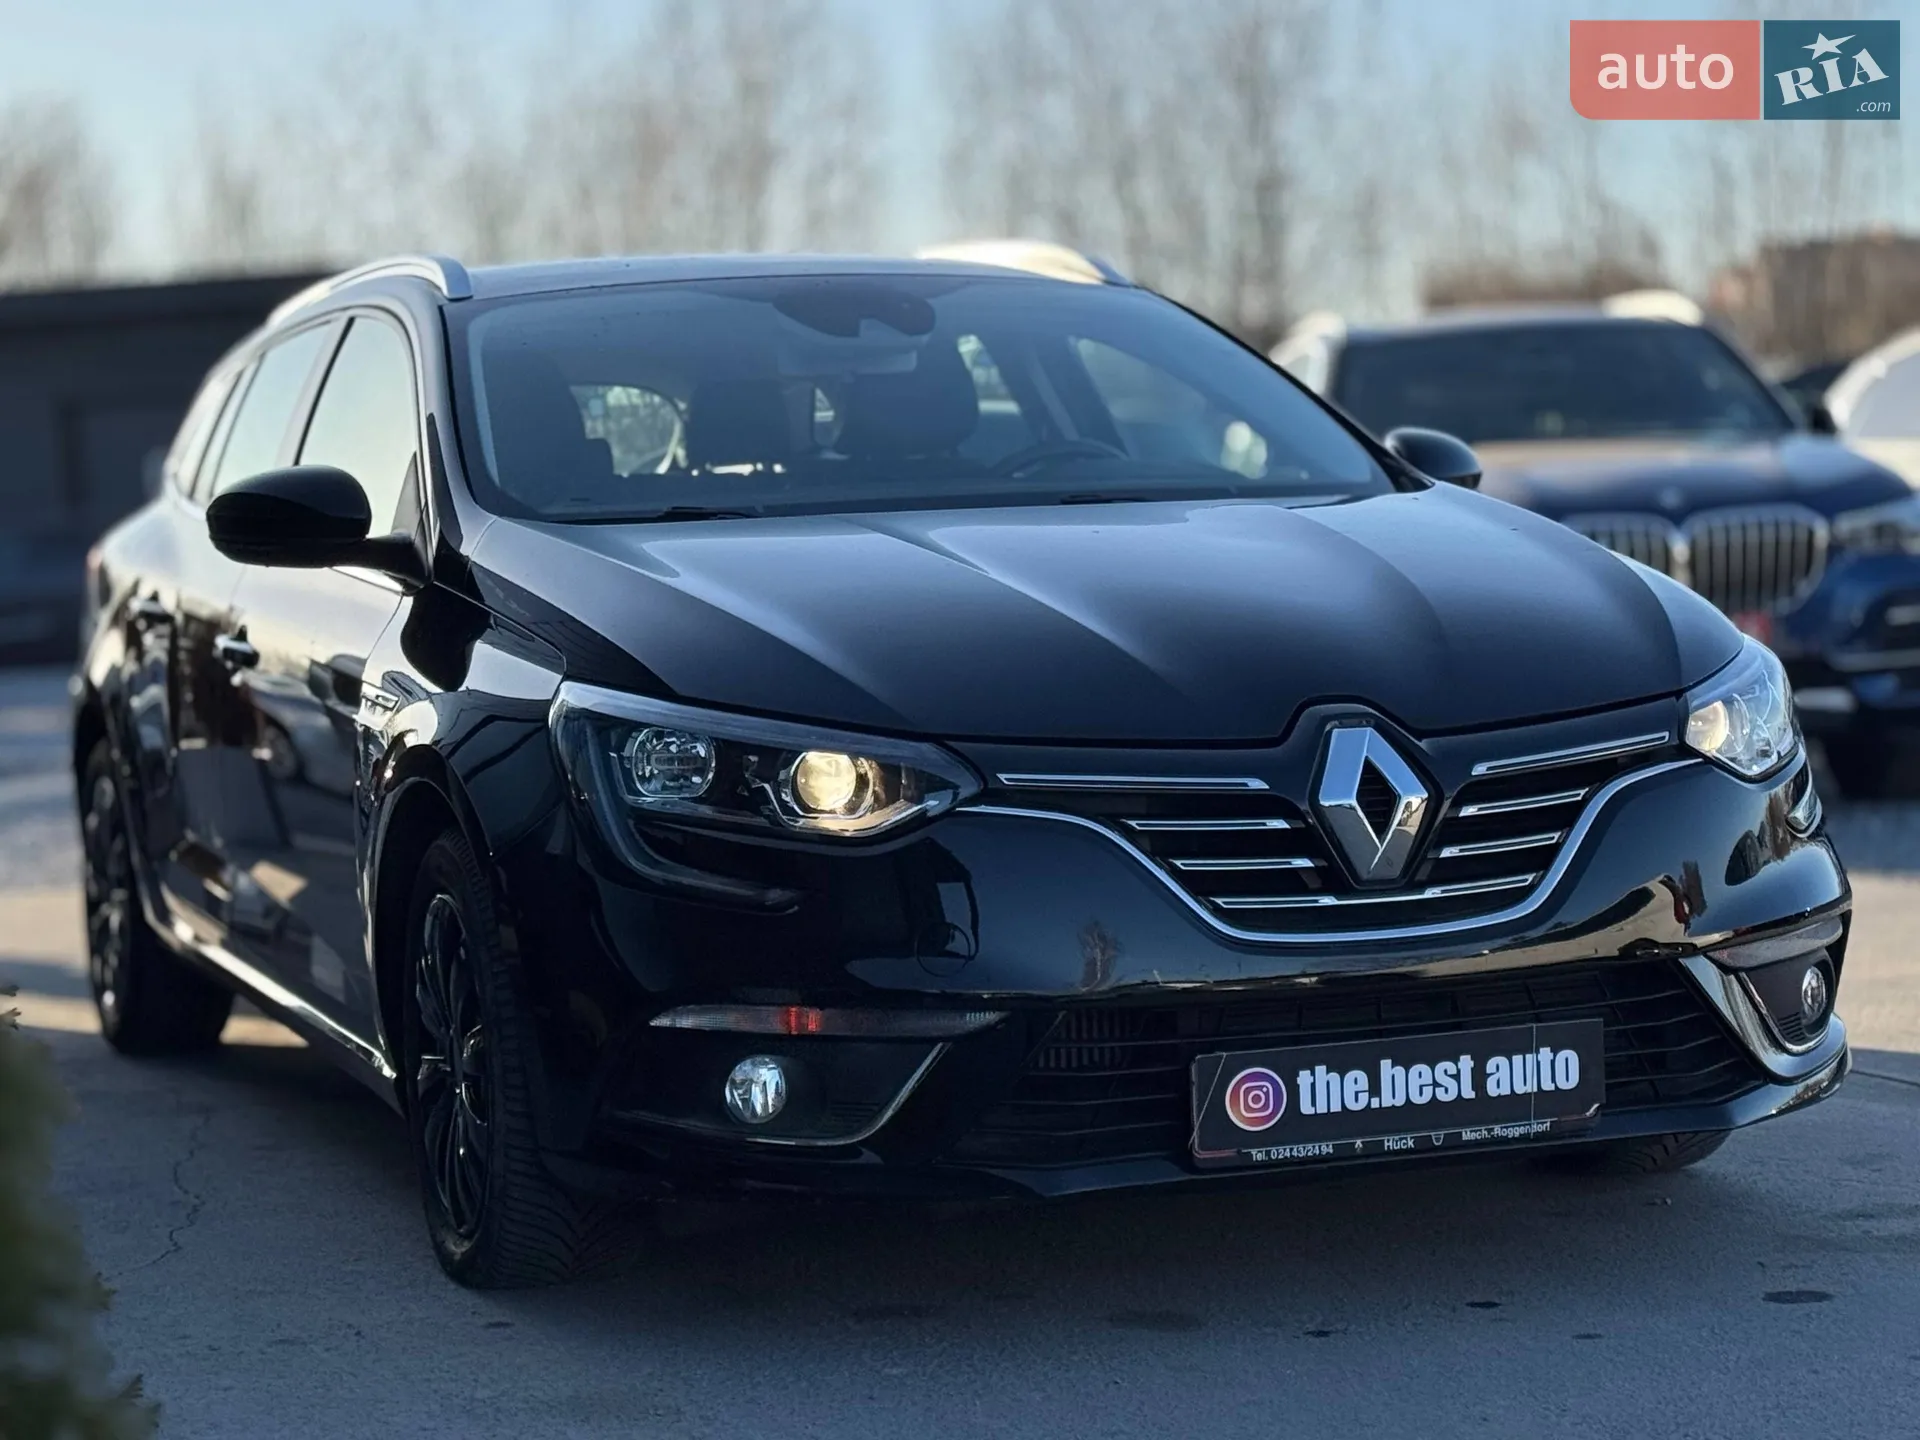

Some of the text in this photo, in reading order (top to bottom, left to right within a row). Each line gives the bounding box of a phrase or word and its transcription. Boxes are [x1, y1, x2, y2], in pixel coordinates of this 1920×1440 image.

[1297, 1047, 1580, 1115] the.best auto
[1251, 1150, 1269, 1162] Tel.
[1384, 1136, 1415, 1151] Hück
